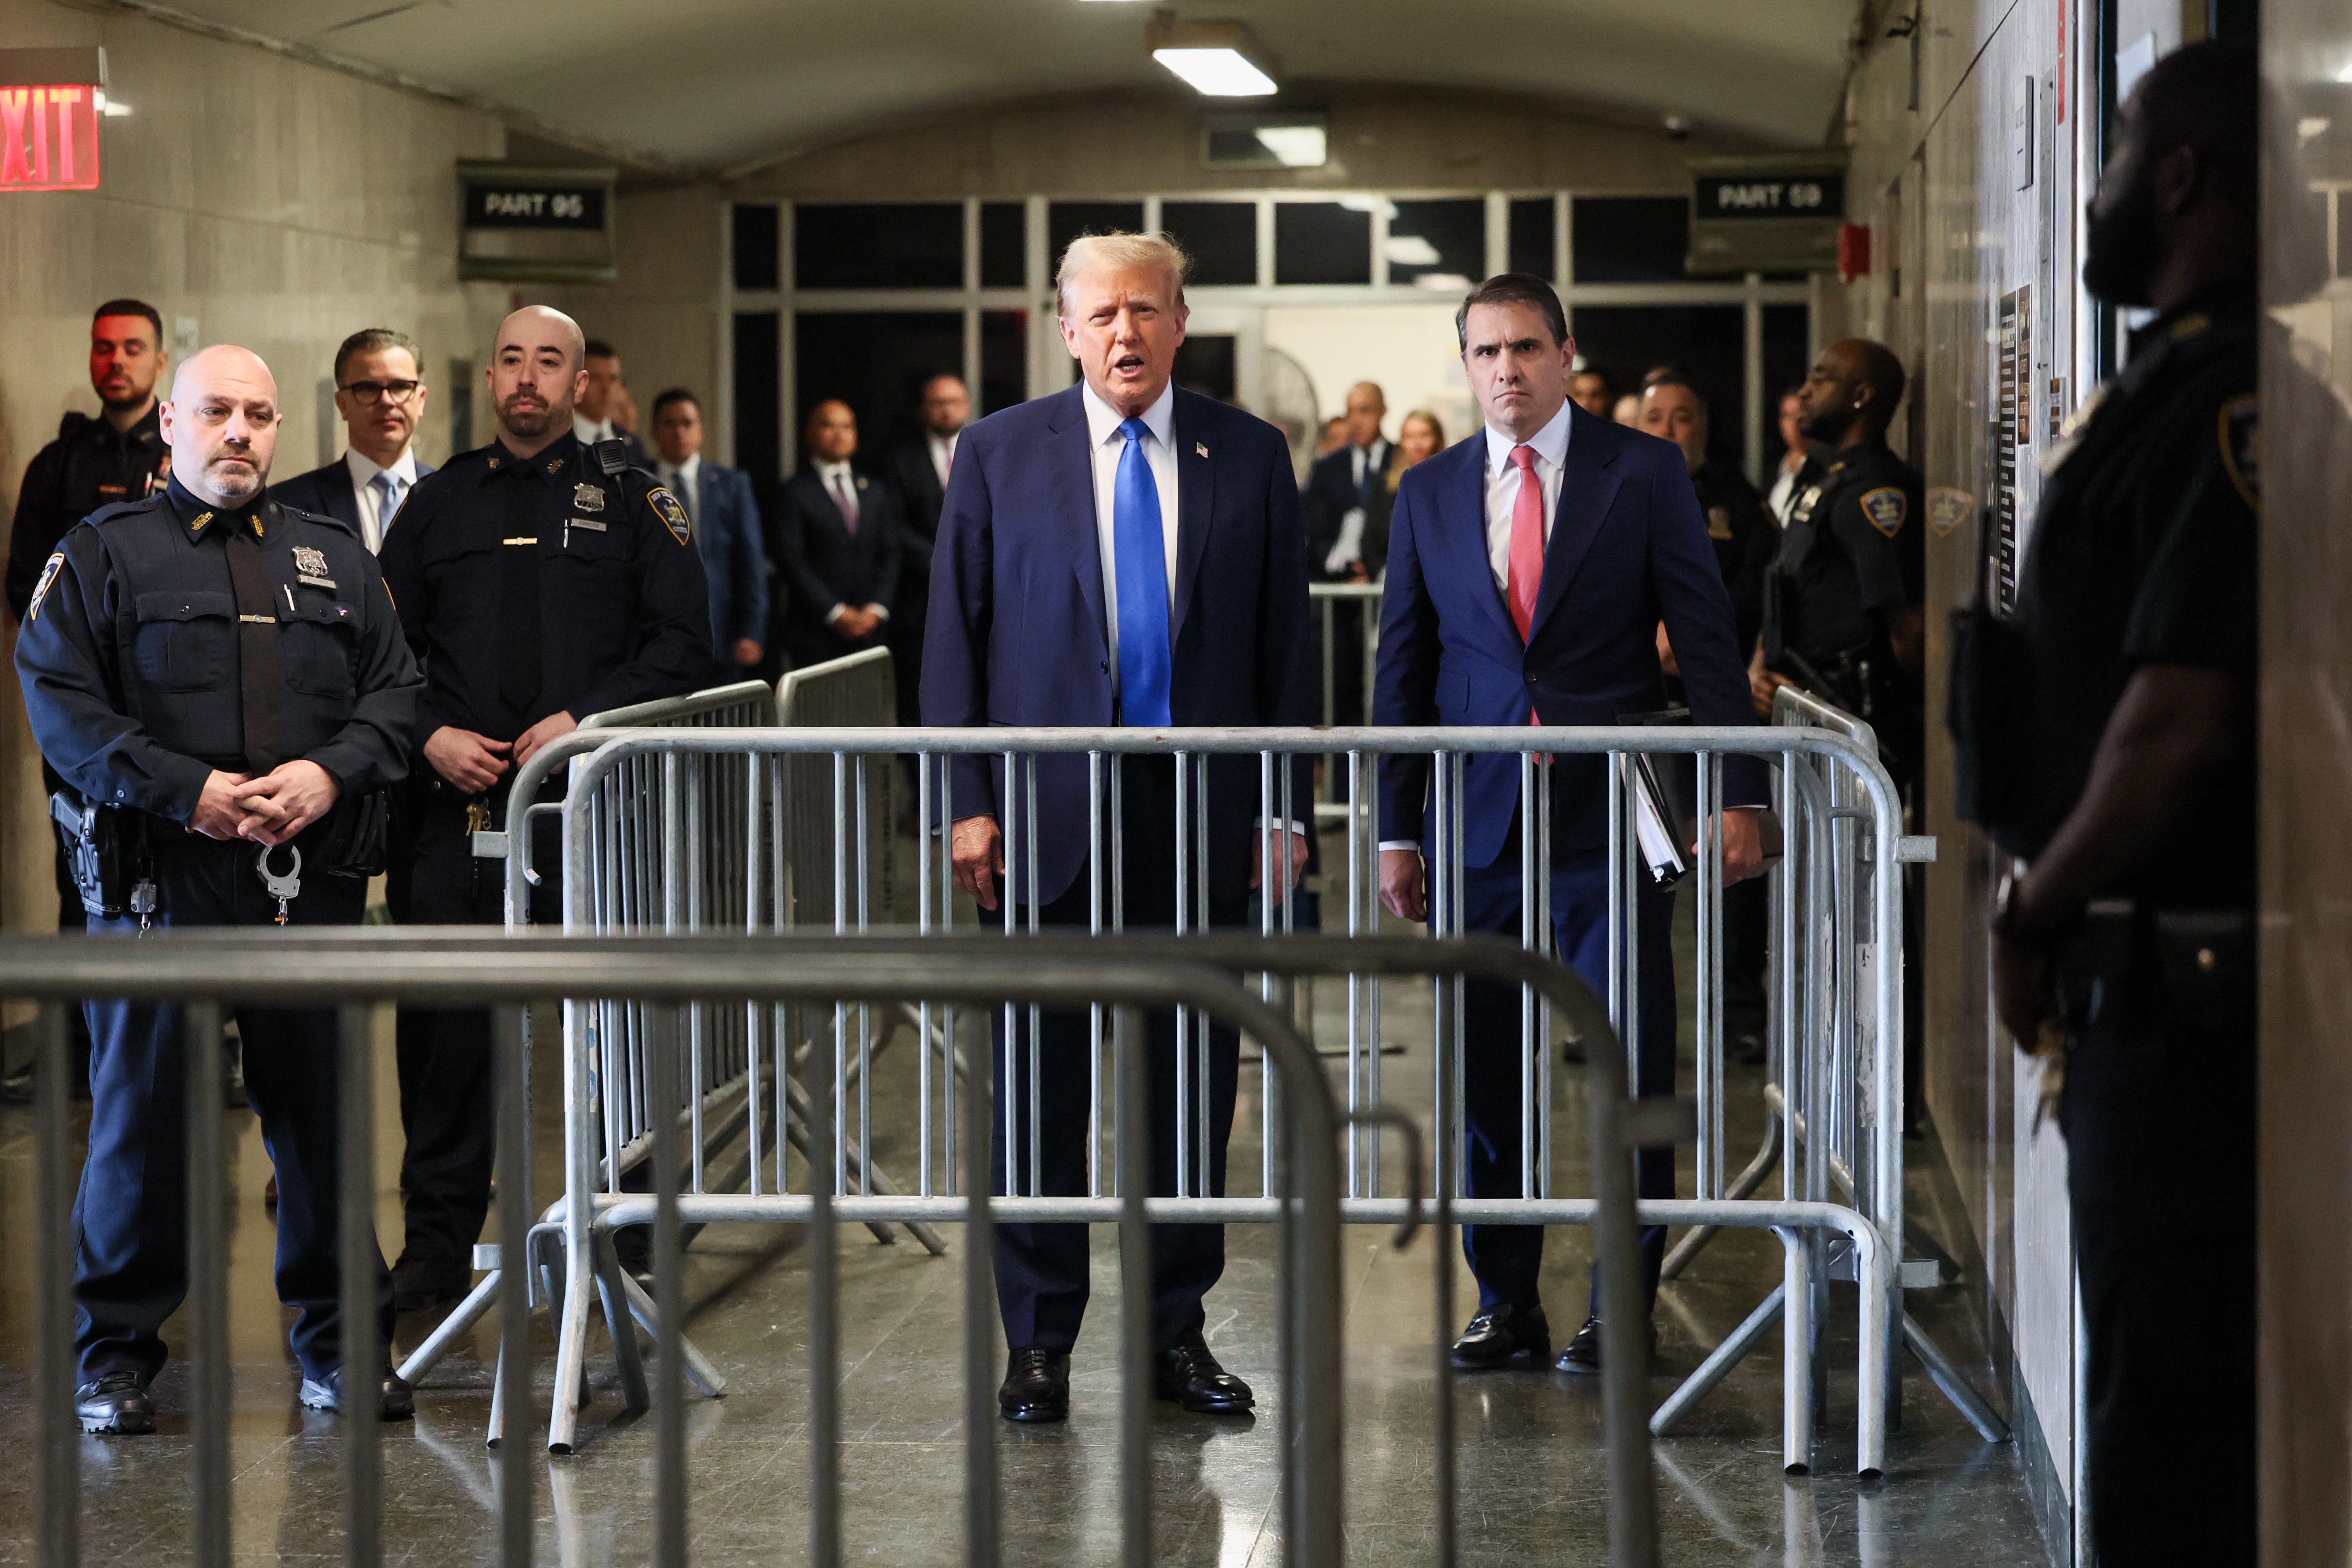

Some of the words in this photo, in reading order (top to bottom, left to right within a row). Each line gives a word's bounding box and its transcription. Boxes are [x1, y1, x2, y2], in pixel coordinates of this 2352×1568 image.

[0, 88, 81, 183] XIT
[485, 192, 547, 217] PART
[1718, 183, 1784, 208] PART
